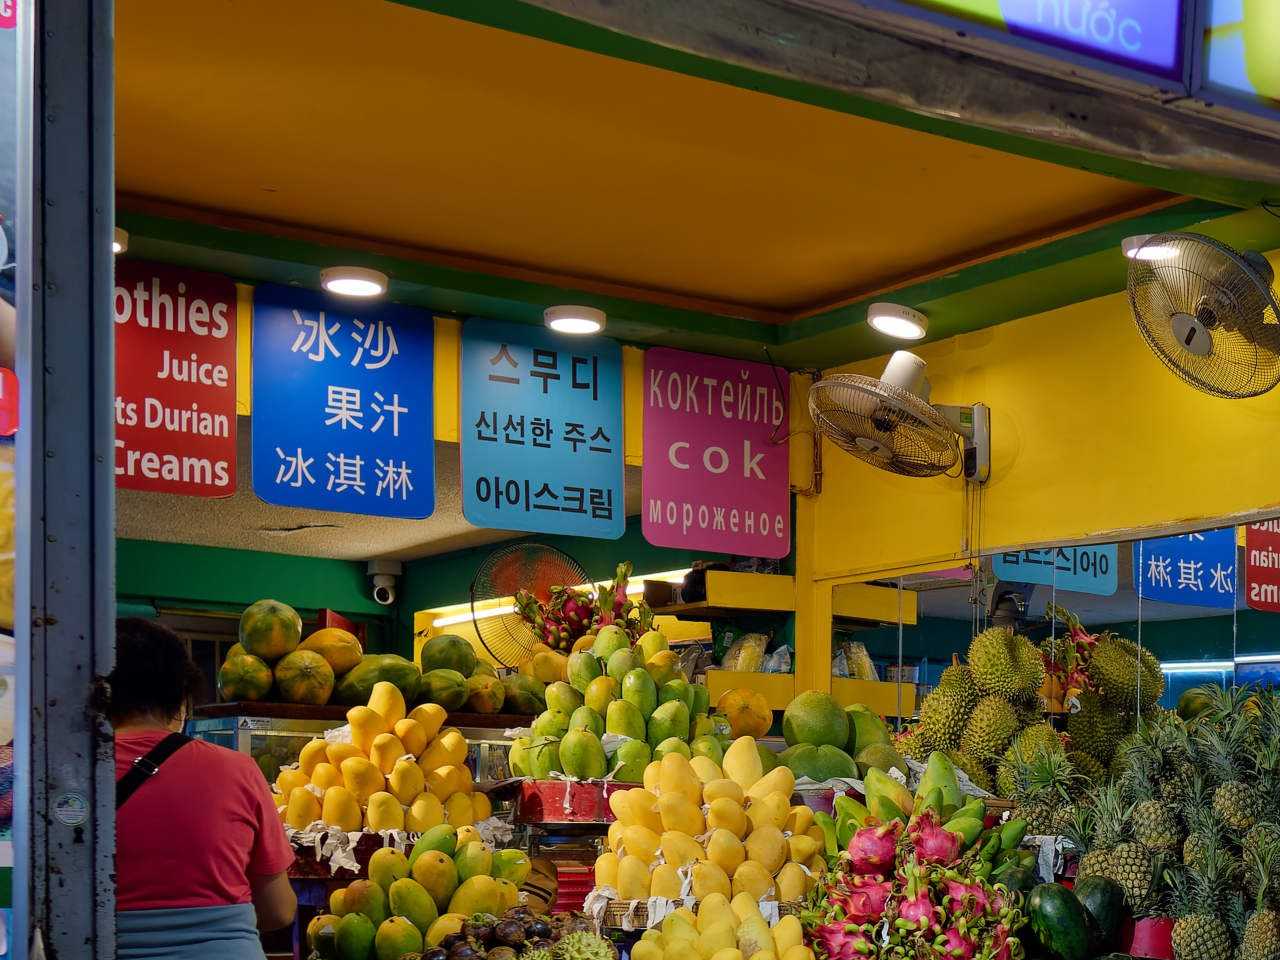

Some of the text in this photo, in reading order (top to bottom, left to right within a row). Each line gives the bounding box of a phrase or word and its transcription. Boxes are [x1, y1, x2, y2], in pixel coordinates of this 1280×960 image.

[291, 309, 399, 371] 冰沙
[157, 350, 228, 387] Juice
[488, 344, 600, 401] 스무디
[144, 398, 229, 438] Durian
[324, 385, 409, 438] 果汁
[475, 409, 613, 455] 신선한 주스
[275, 446, 414, 501] 冰淇淋
[475, 475, 614, 521] 아이스크림
[648, 497, 784, 539] мороженое
